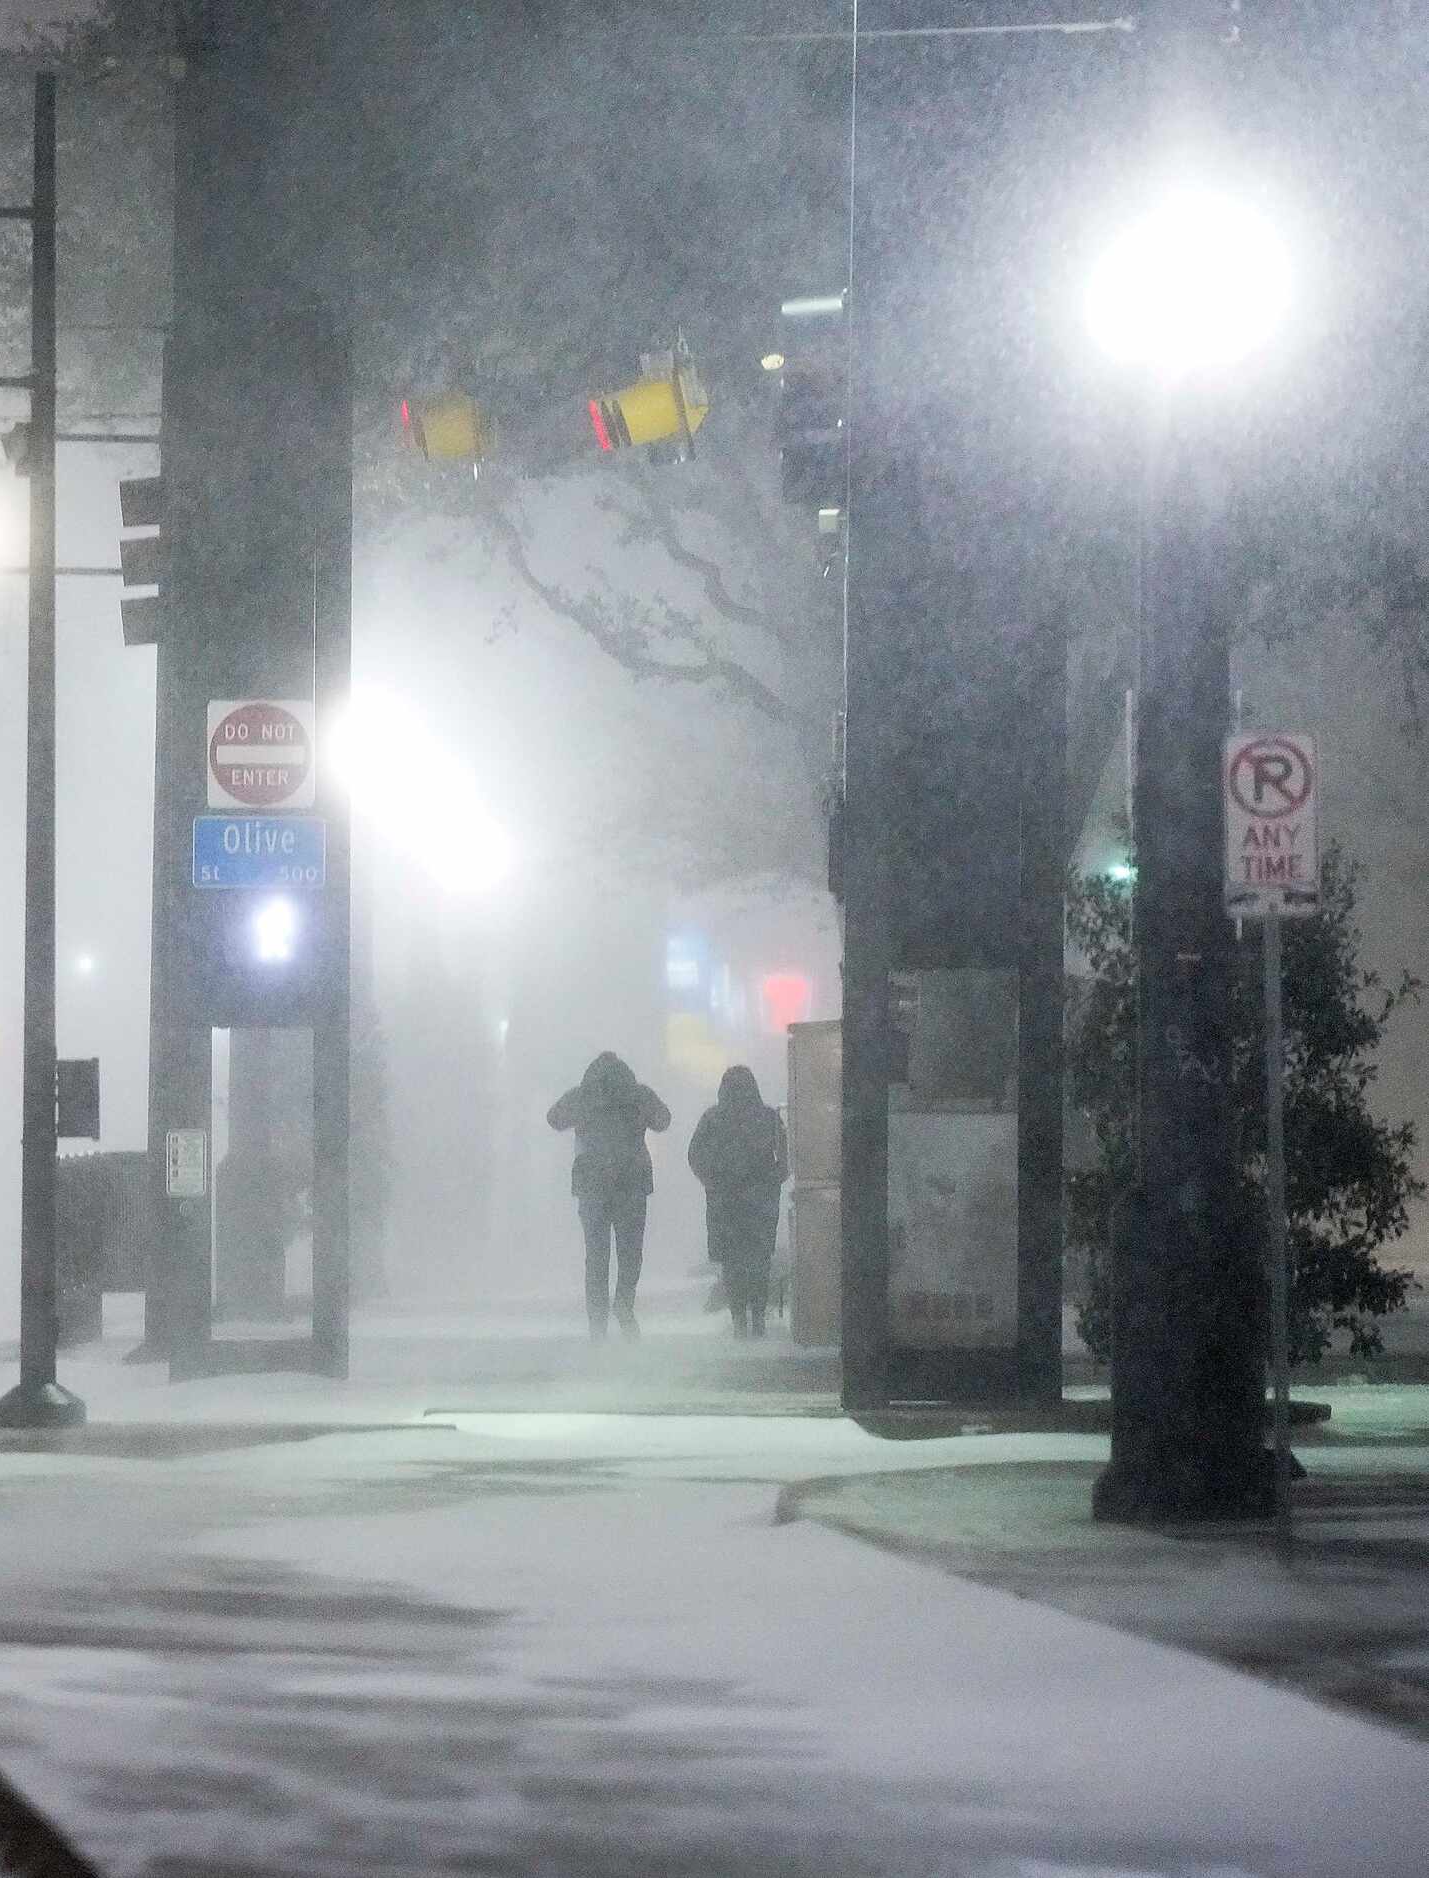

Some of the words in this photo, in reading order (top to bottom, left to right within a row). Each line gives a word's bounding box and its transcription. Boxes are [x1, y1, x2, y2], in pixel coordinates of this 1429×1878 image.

[225, 723, 249, 740] DO
[261, 723, 295, 740] NOT
[231, 768, 289, 786] ENTER
[223, 821, 296, 854] Olive
[1243, 823, 1302, 847] ANY
[1240, 854, 1304, 881] TIME
